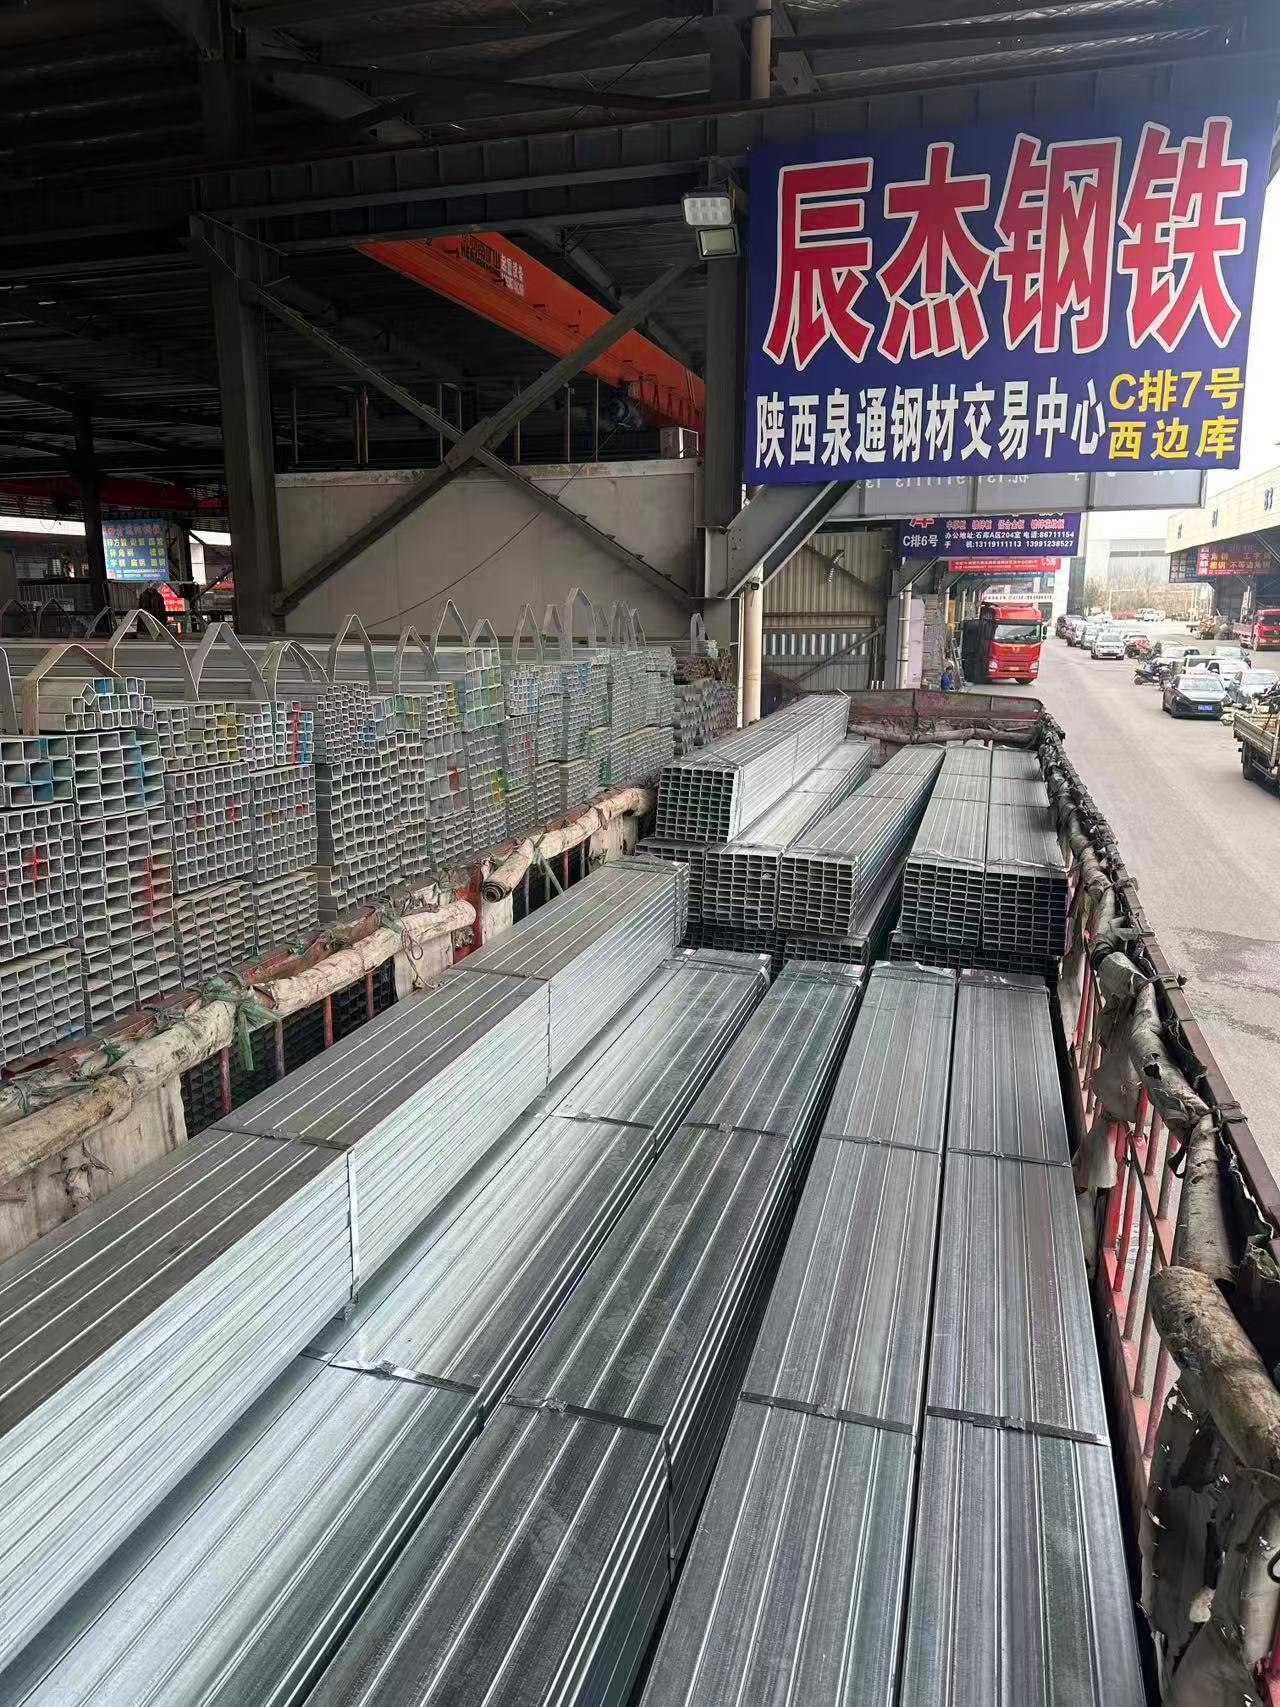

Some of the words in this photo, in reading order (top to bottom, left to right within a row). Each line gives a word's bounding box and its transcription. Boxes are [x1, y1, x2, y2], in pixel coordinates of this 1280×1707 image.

[762, 116, 1248, 371] 辰杰钢铁
[1109, 367, 1244, 414] C排7号
[755, 377, 1106, 468] 陕西泉通钢材交易中心
[1108, 416, 1240, 459] 西边库
[902, 534, 939, 547] C排6号
